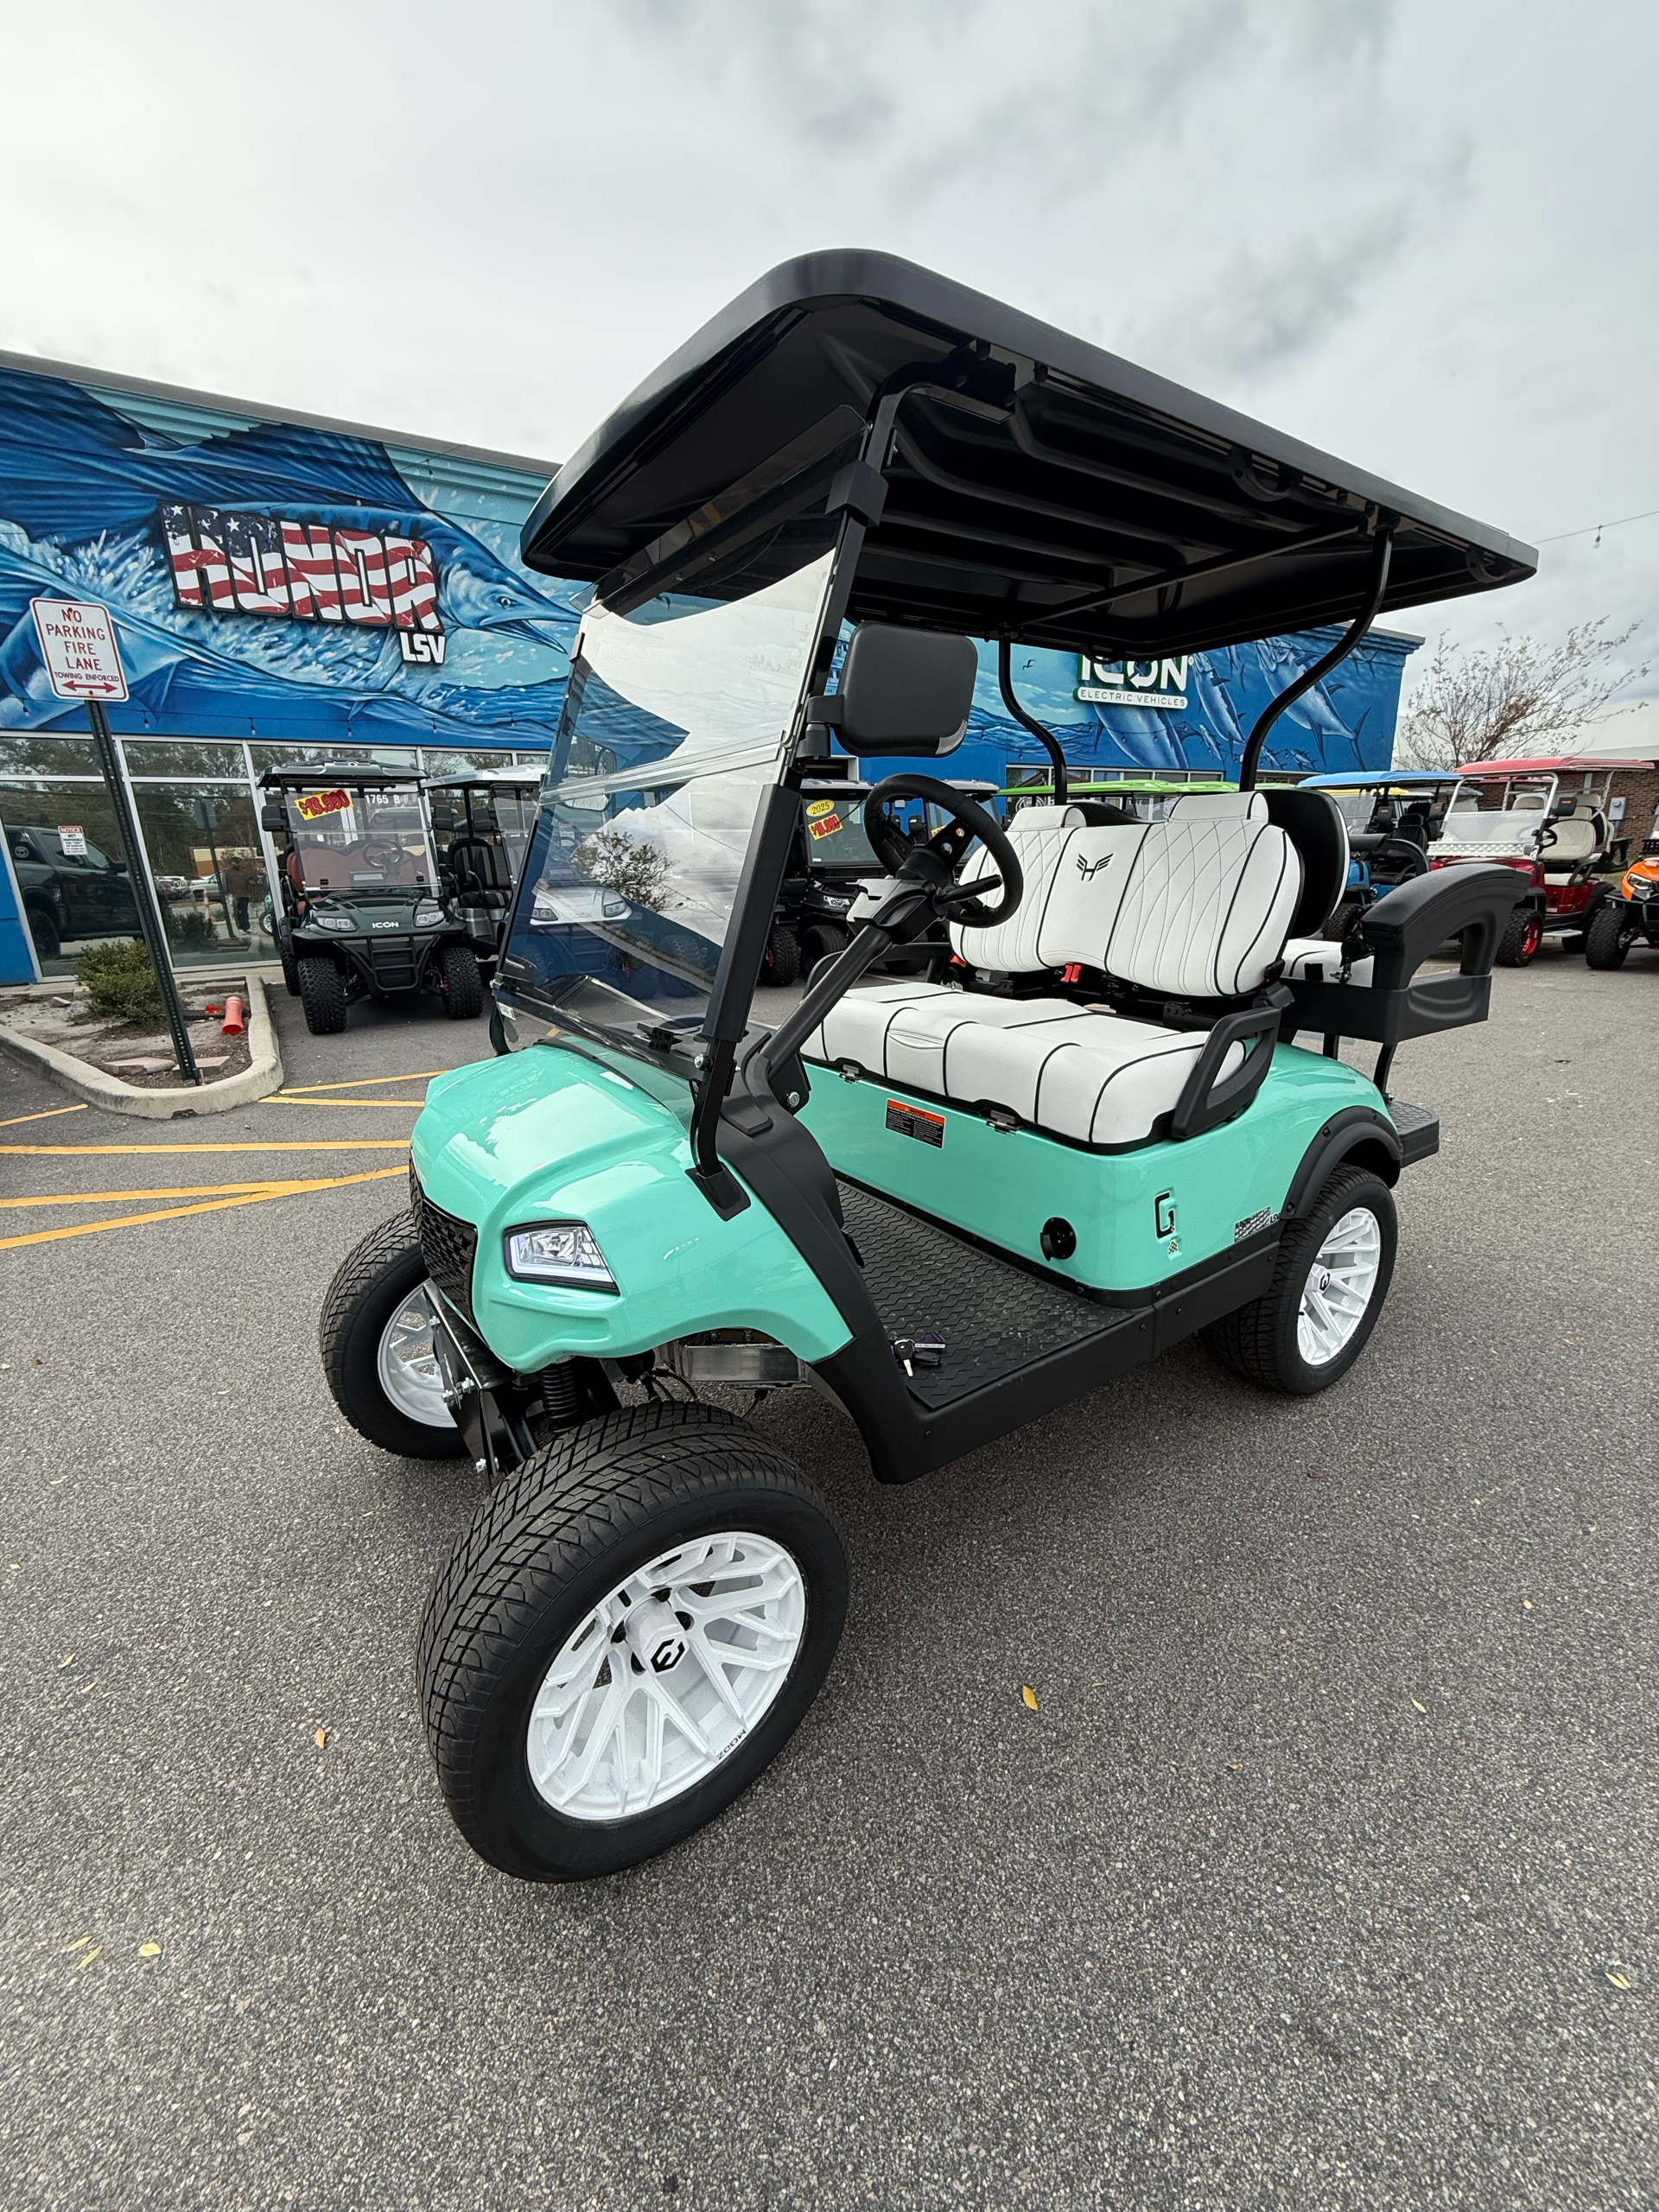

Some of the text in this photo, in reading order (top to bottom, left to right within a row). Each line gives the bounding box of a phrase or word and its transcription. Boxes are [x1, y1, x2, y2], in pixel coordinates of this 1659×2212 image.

[157, 499, 445, 632] HONOR
[61, 607, 82, 622] NO
[46, 624, 105, 640] PARKING
[64, 641, 96, 655] FIRE
[399, 632, 445, 664] LSV
[66, 657, 102, 671] LANE
[54, 671, 120, 683] TOWING ENFORCED
[1080, 690, 1185, 708] ELECTRIC VEHICLES
[365, 794, 389, 804] 1765
[812, 801, 830, 815] 2025
[716, 1729, 747, 1760] MODZ
